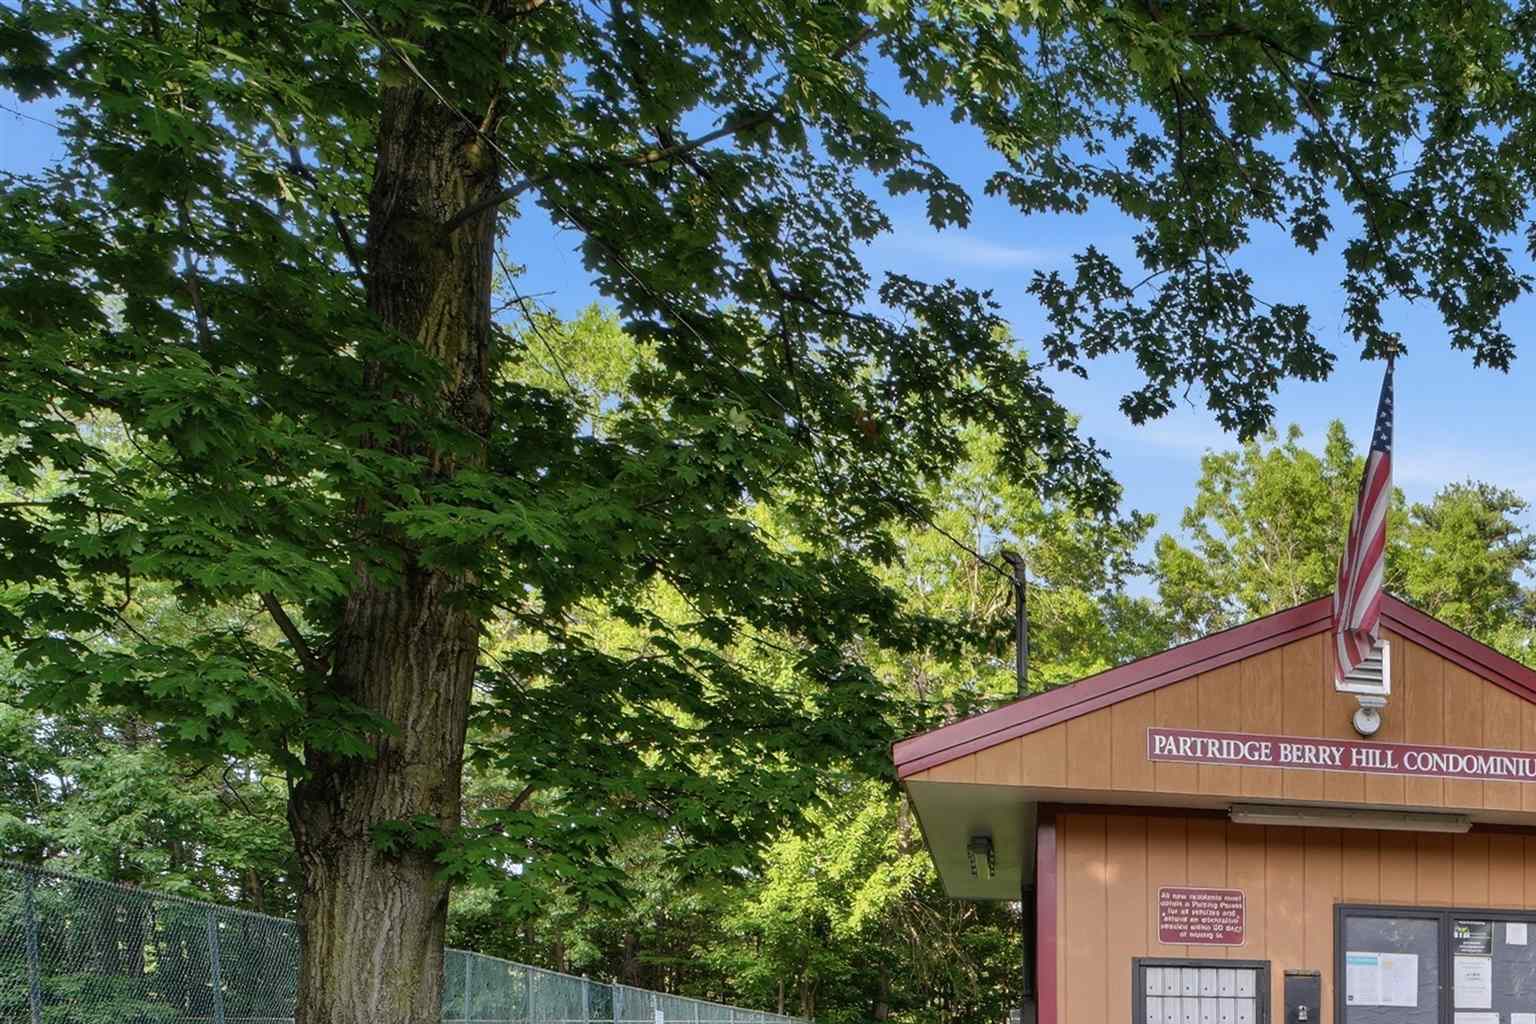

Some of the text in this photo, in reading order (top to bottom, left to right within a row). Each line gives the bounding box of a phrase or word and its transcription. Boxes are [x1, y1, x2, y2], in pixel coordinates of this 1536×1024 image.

[1153, 734, 1273, 762] PARTRIDGE
[1279, 743, 1344, 767] BERRY
[1350, 747, 1398, 769] HILL
